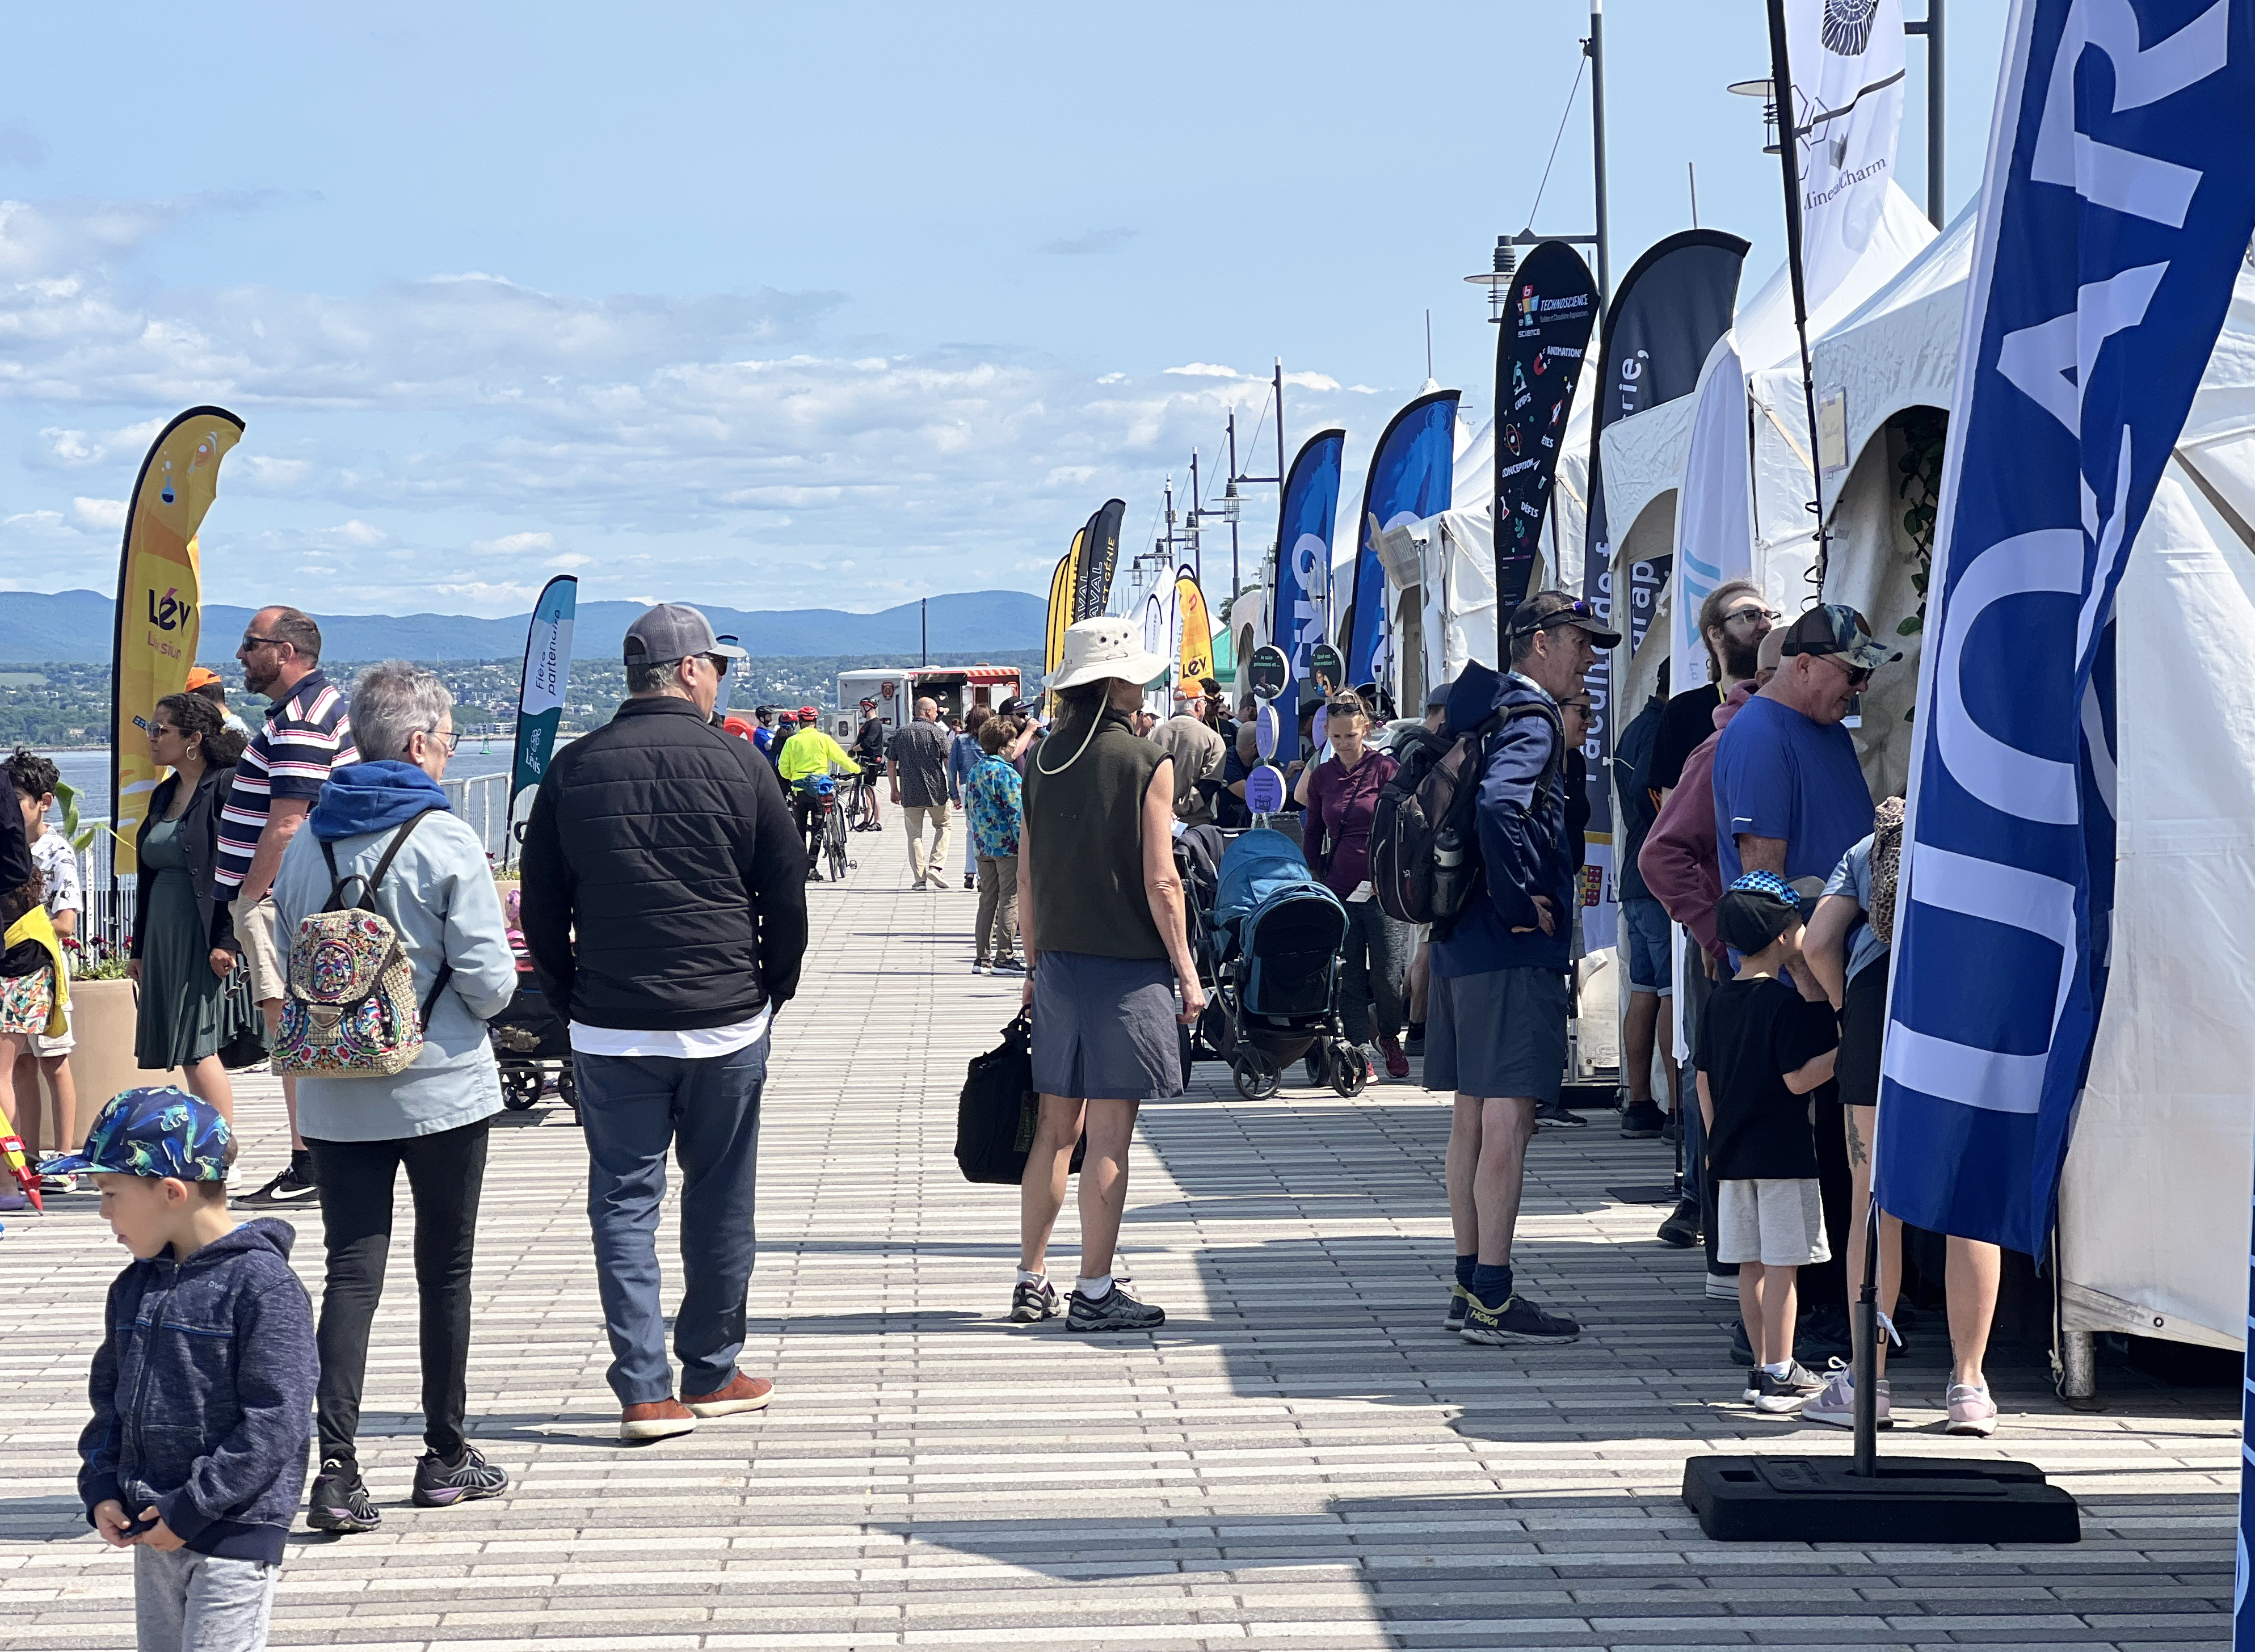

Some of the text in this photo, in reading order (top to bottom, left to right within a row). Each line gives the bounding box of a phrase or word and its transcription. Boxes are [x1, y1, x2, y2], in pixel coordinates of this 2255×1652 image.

[1541, 293, 1588, 312] TECHNOSCIENCE
[1514, 393, 1532, 411] CAMPS
[1521, 501, 1539, 518] DÉFIS
[1104, 536, 1116, 582] GÉNIE
[1077, 570, 1089, 623] AVAL
[1088, 560, 1103, 619] AVAL
[547, 609, 561, 696] partenaire
[1403, 869, 1411, 878] 35
[1470, 1309, 1499, 1328] HOKA
